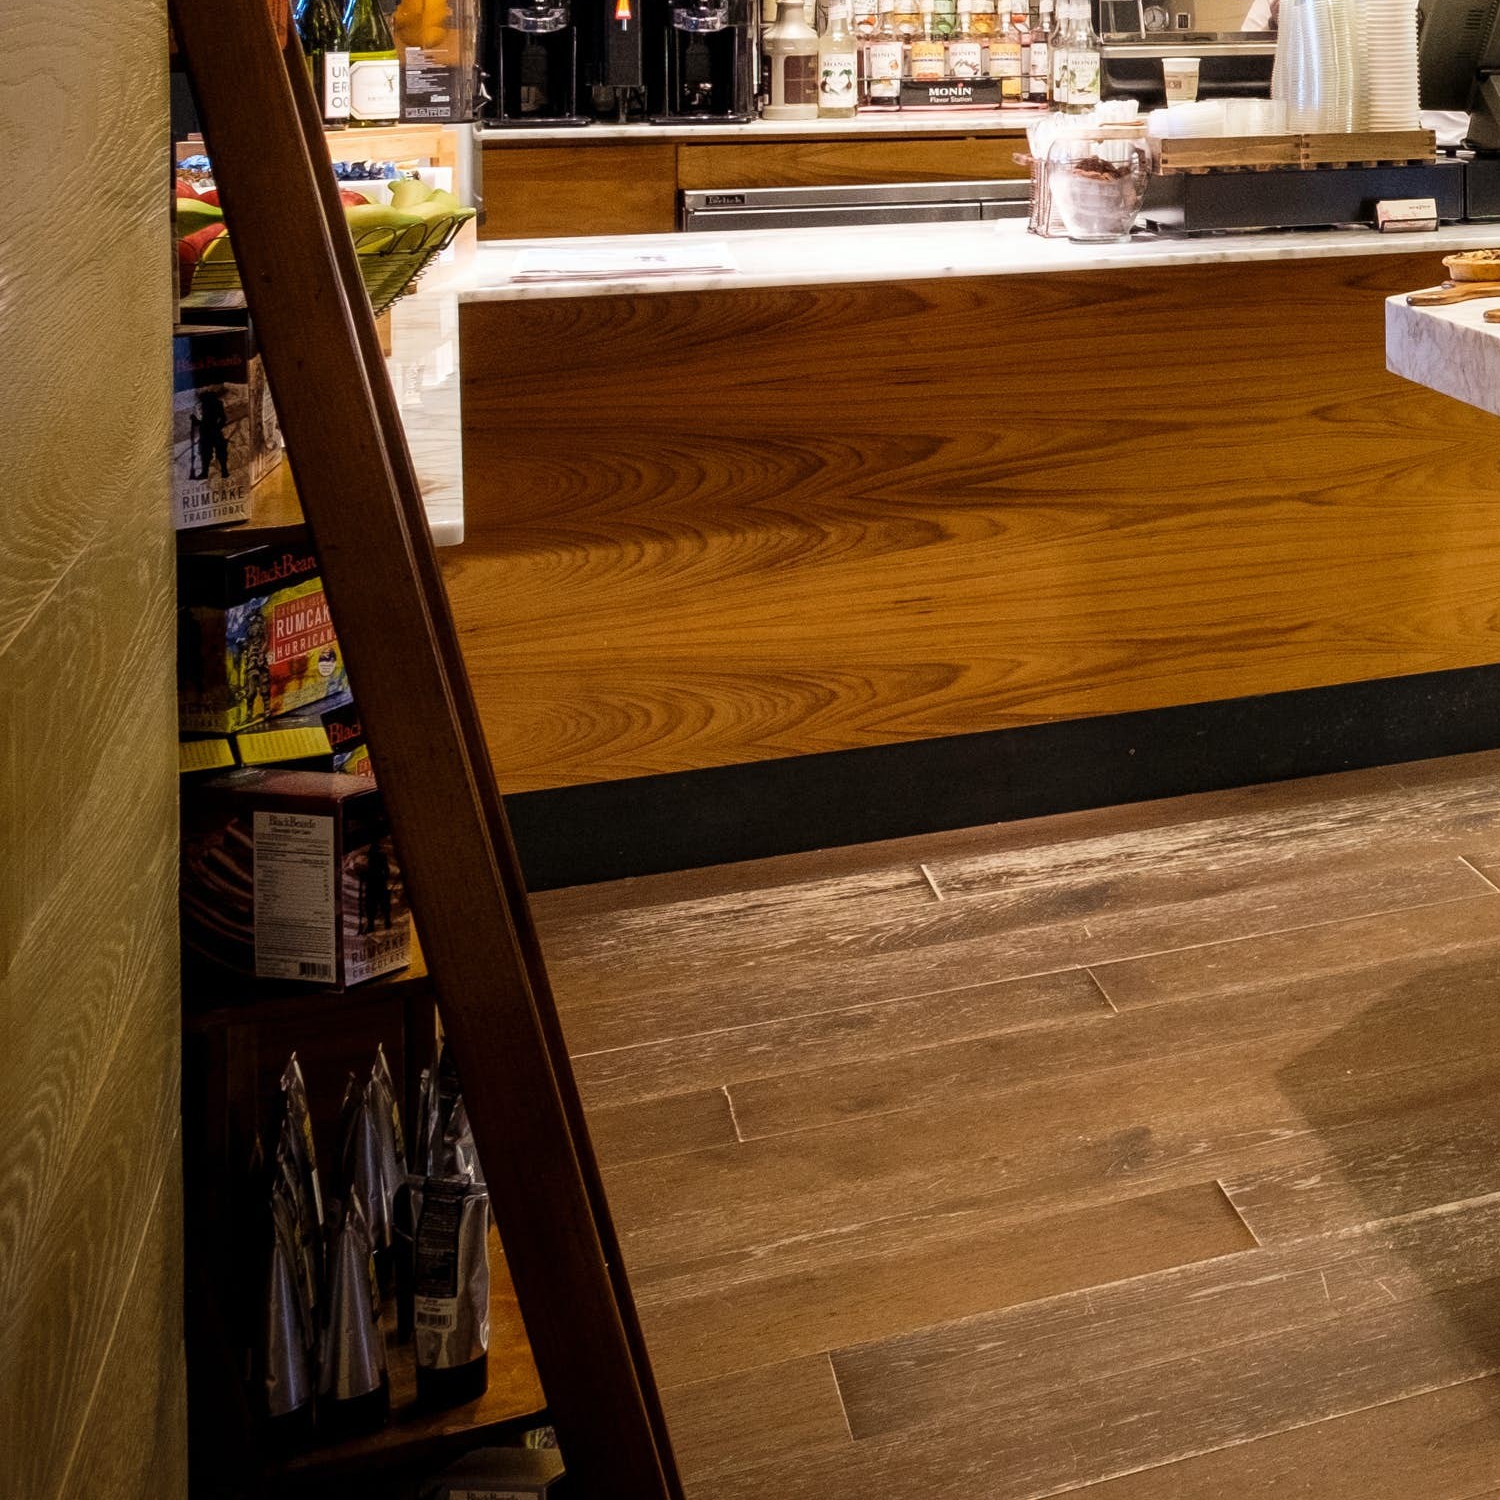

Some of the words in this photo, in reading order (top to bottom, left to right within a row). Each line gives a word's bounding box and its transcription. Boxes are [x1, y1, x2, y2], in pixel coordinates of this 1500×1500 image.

[928, 84, 973, 97] MONIN
[183, 486, 245, 510] RUMCAKE
[184, 504, 245, 524] TRADITIONAL
[277, 604, 331, 639] RUMCAK
[277, 629, 338, 657] HURRICAN
